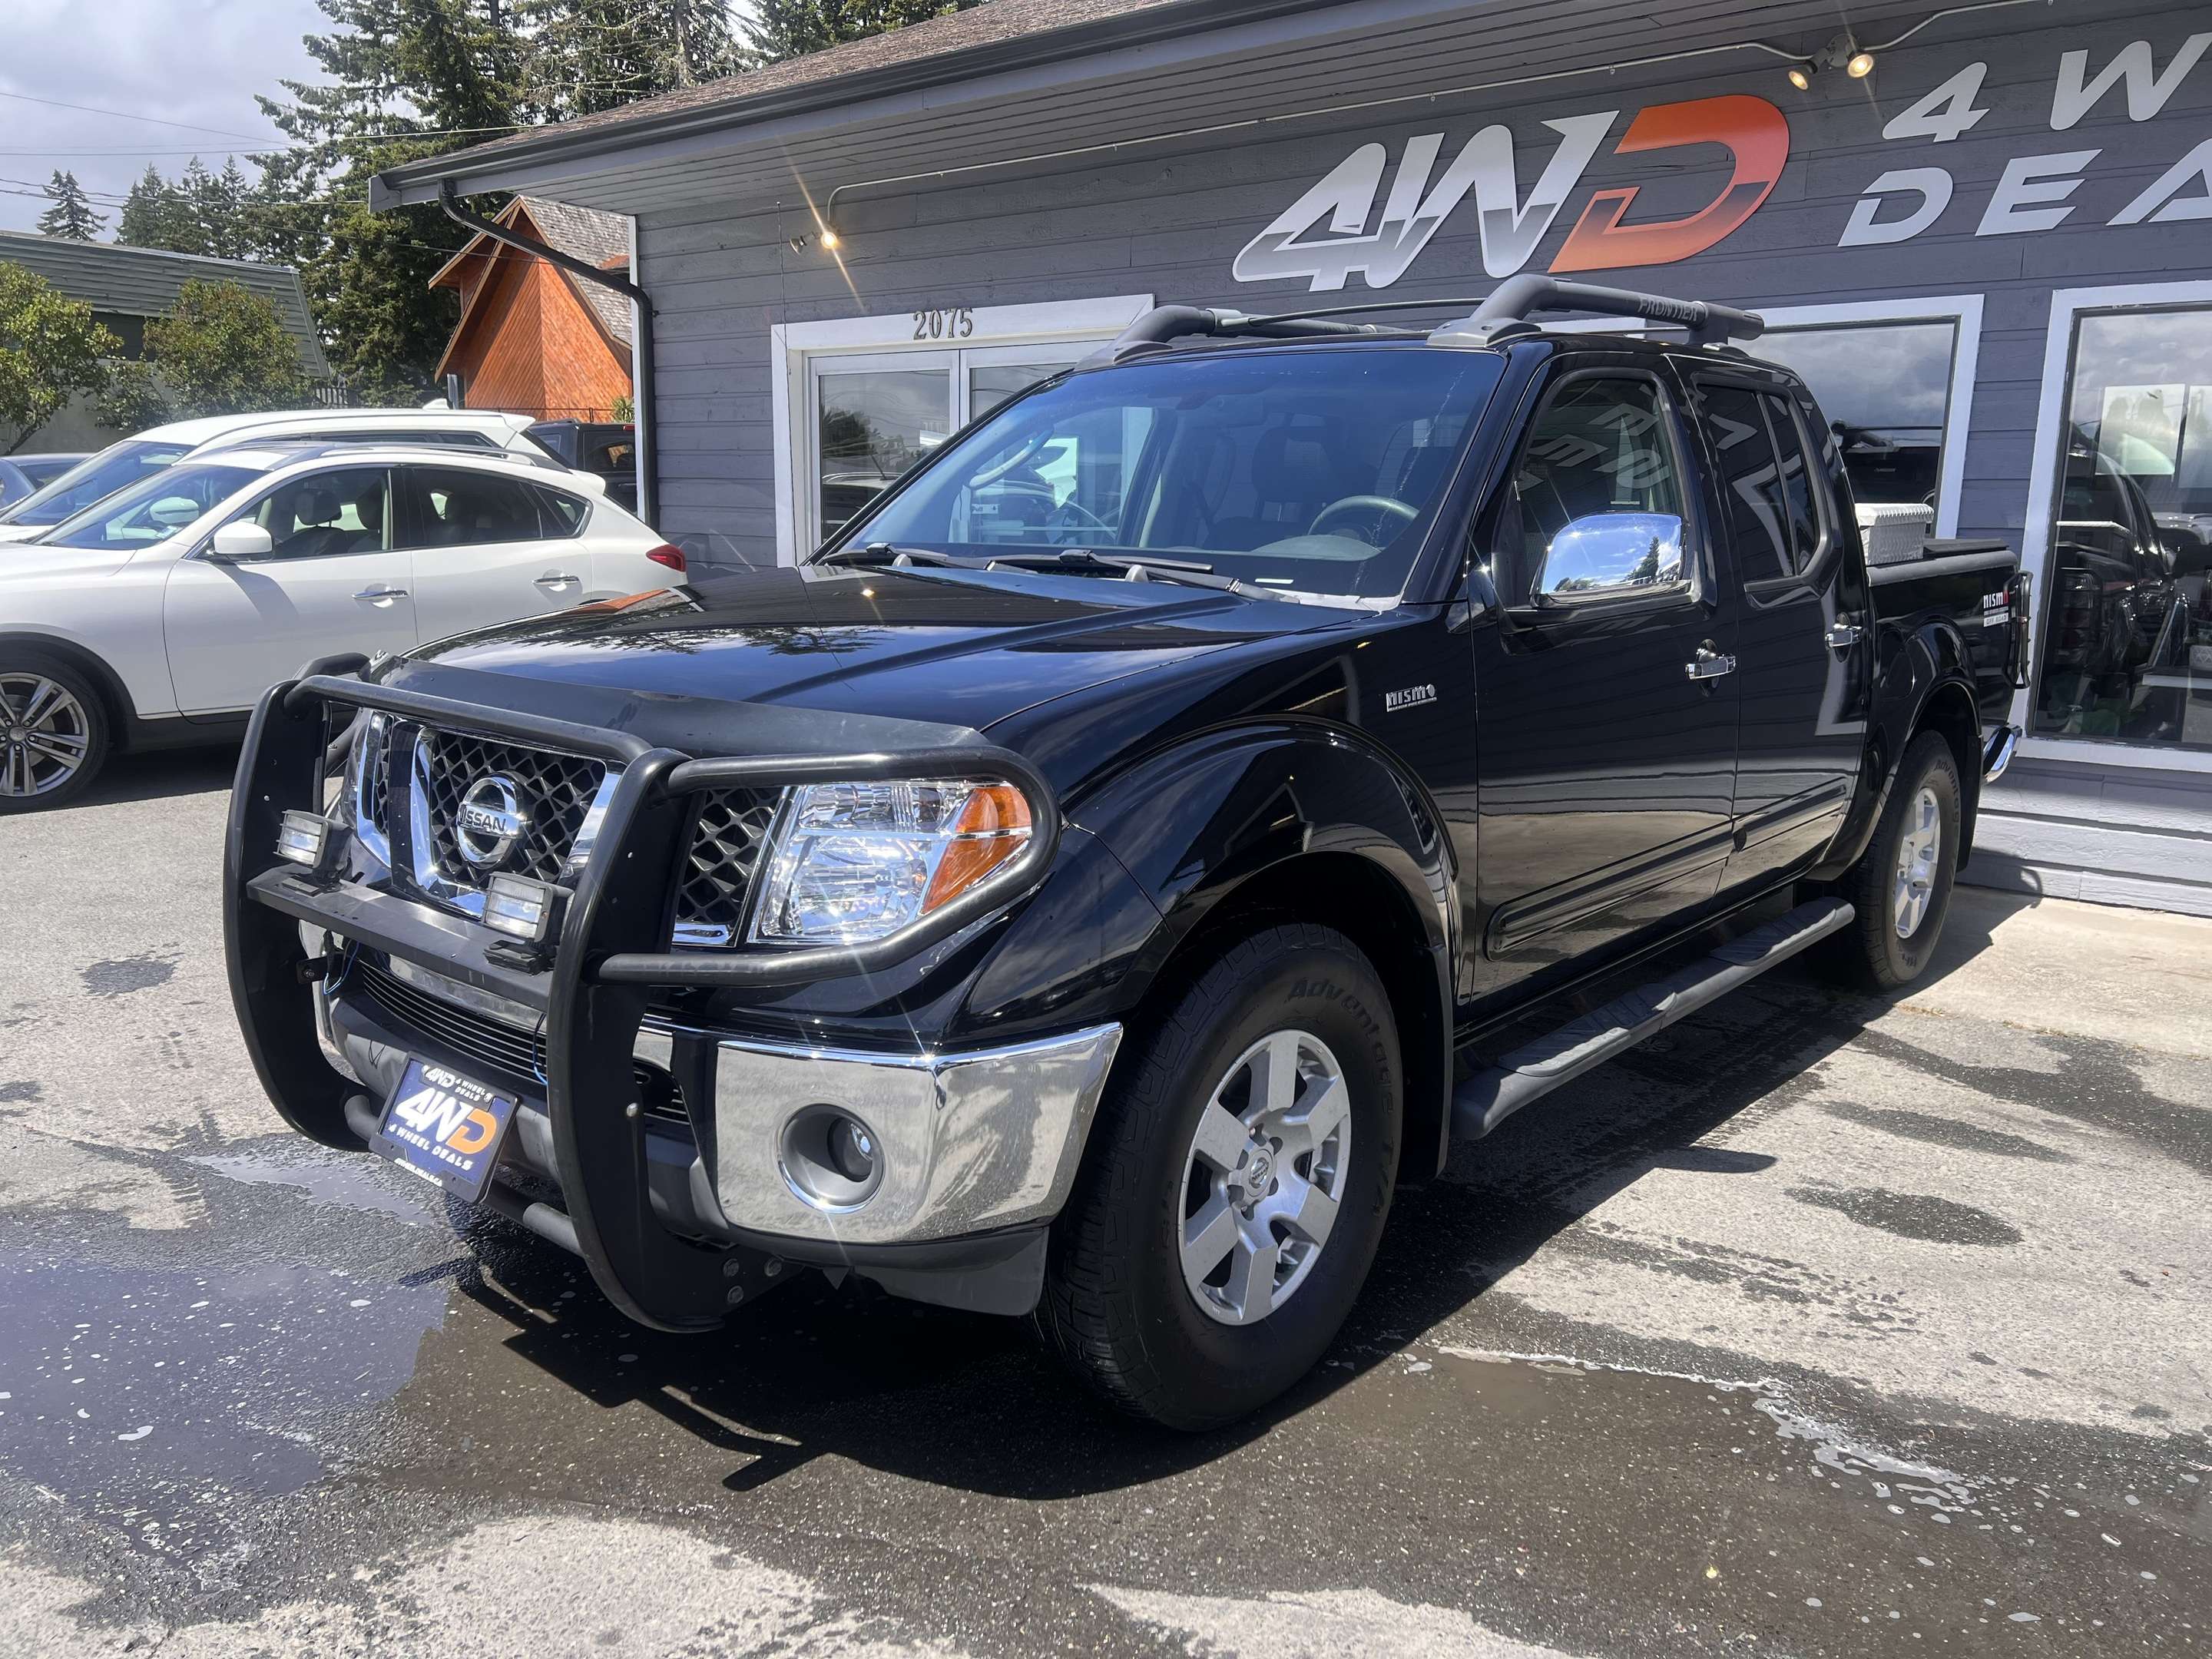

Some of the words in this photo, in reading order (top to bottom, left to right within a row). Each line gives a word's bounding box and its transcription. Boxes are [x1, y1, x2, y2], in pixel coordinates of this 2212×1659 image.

[1883, 61, 1991, 143] 4
[1637, 296, 1698, 322] FRONTIER
[912, 307, 973, 339] 2075
[460, 806, 507, 831] NISSAN
[455, 1086, 482, 1101] DEALS
[462, 1080, 486, 1096] WHEEL
[388, 1124, 397, 1133] 4
[396, 1127, 430, 1151] WHEEL
[432, 1145, 474, 1171] DEALS
